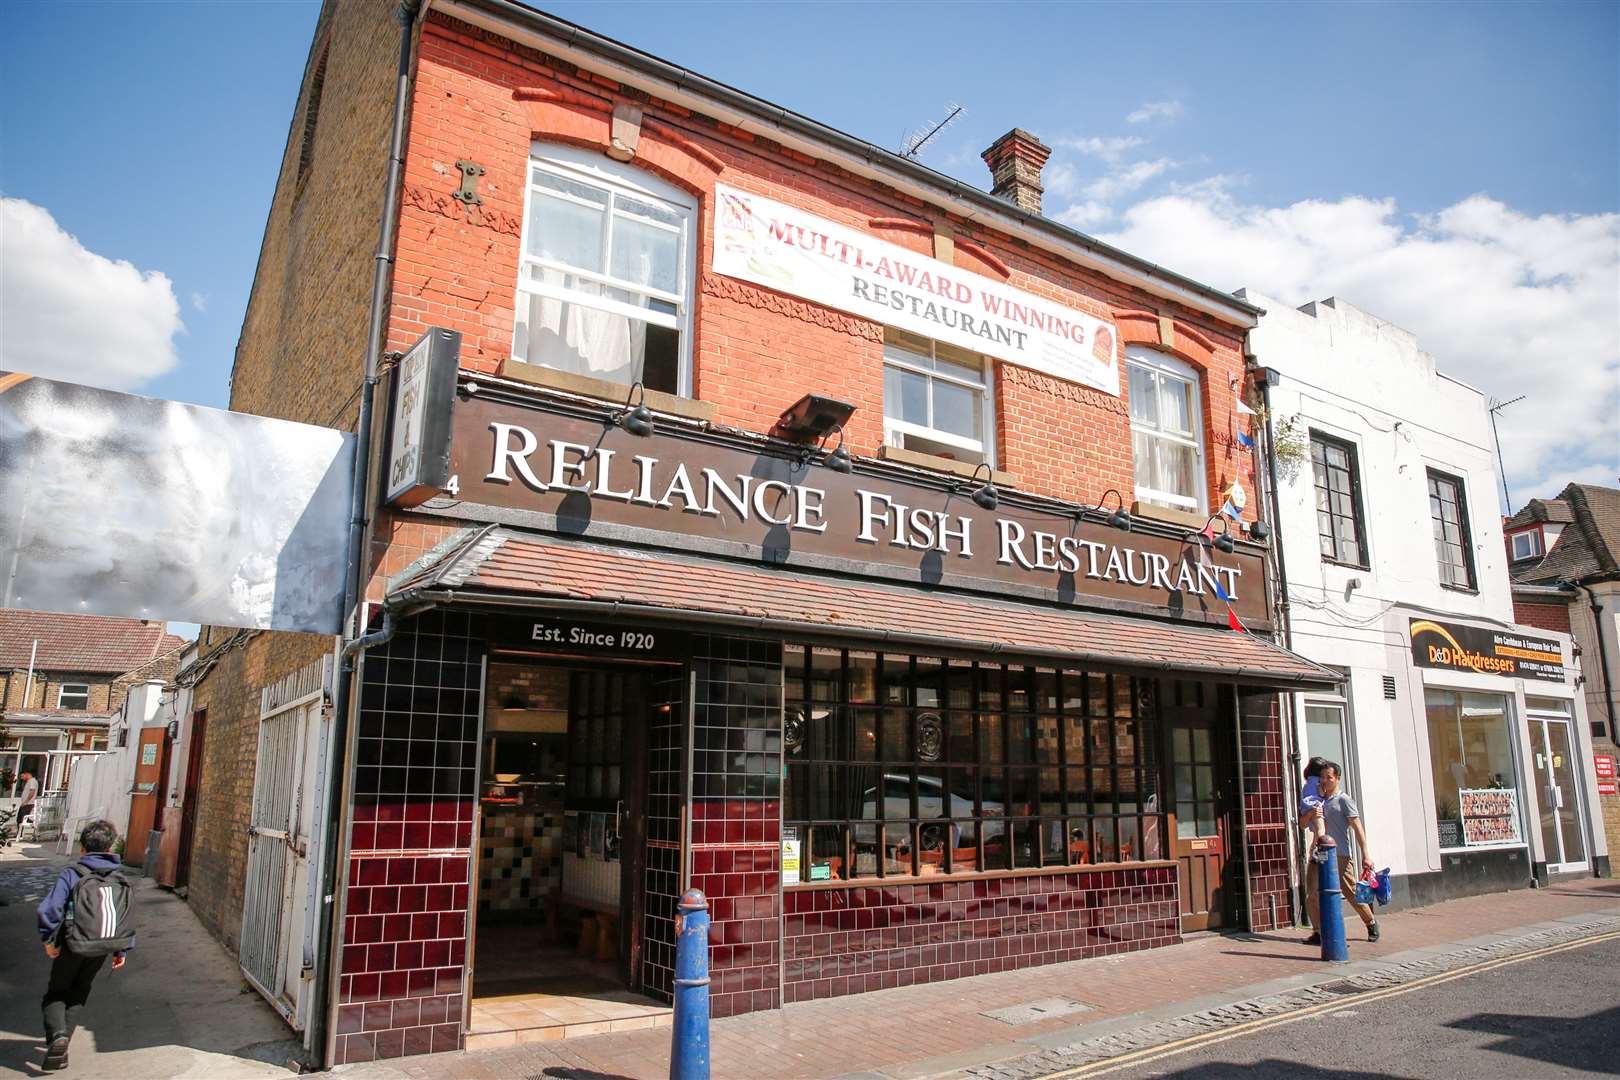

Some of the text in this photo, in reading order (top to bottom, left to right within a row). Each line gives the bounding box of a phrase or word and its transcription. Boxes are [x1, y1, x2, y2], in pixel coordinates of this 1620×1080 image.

[768, 218, 1086, 344] MULTI-AWARD WINNING
[852, 275, 1028, 350] RESTAURANT
[392, 446, 417, 487] CHIPS
[486, 422, 1242, 601] RELIANCE FISH RESTAURANT
[532, 623, 655, 650] Est. Since 1920
[1429, 645, 1451, 664] D&D
[1452, 648, 1515, 672] Hairdressers
